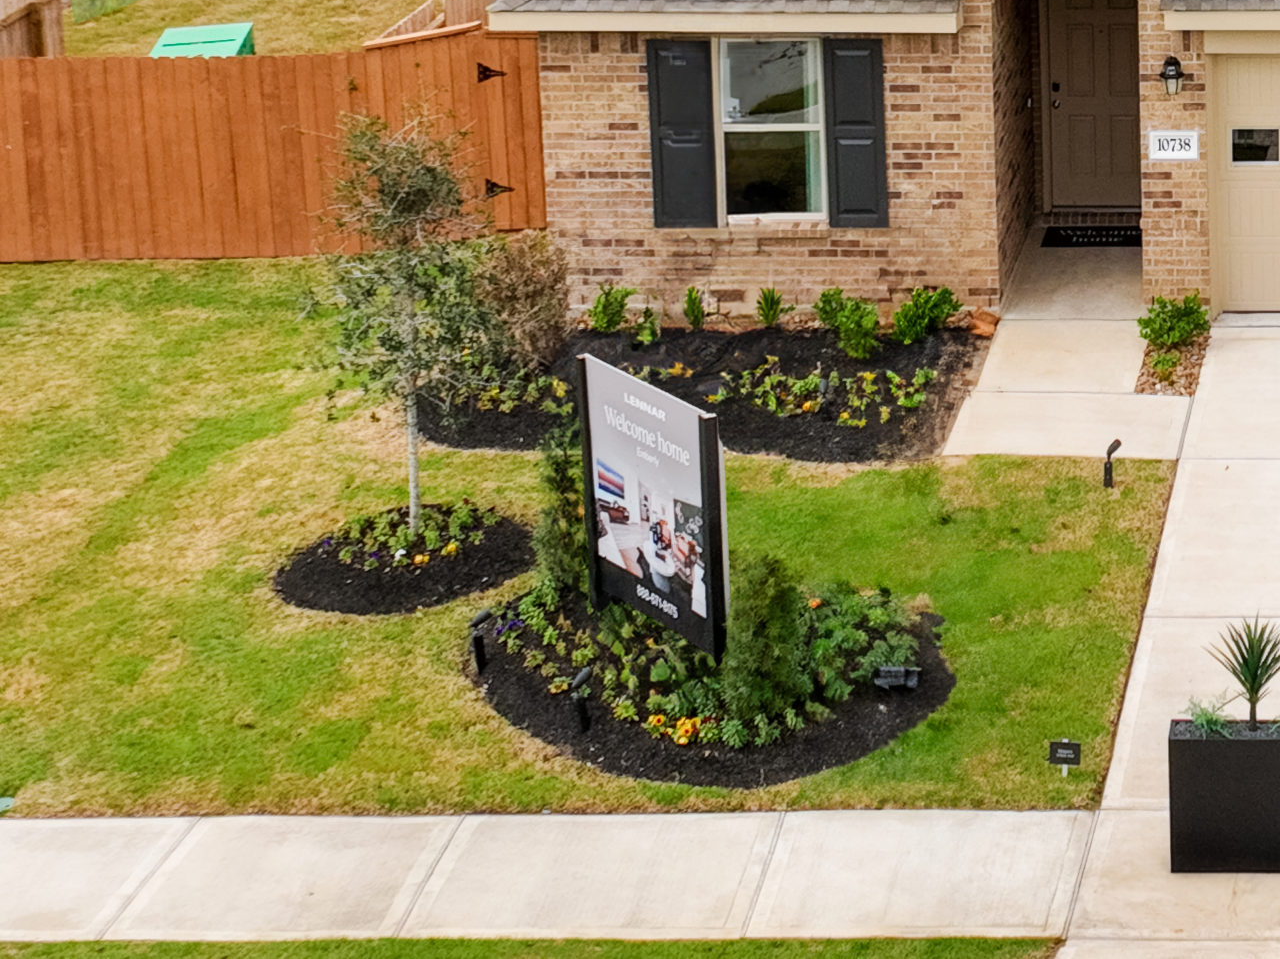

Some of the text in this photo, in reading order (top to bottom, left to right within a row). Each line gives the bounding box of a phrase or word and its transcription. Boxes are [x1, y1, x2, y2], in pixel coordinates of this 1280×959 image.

[1157, 138, 1191, 152] 10738
[624, 393, 666, 421] LENNAR
[604, 405, 690, 466] Welcome home
